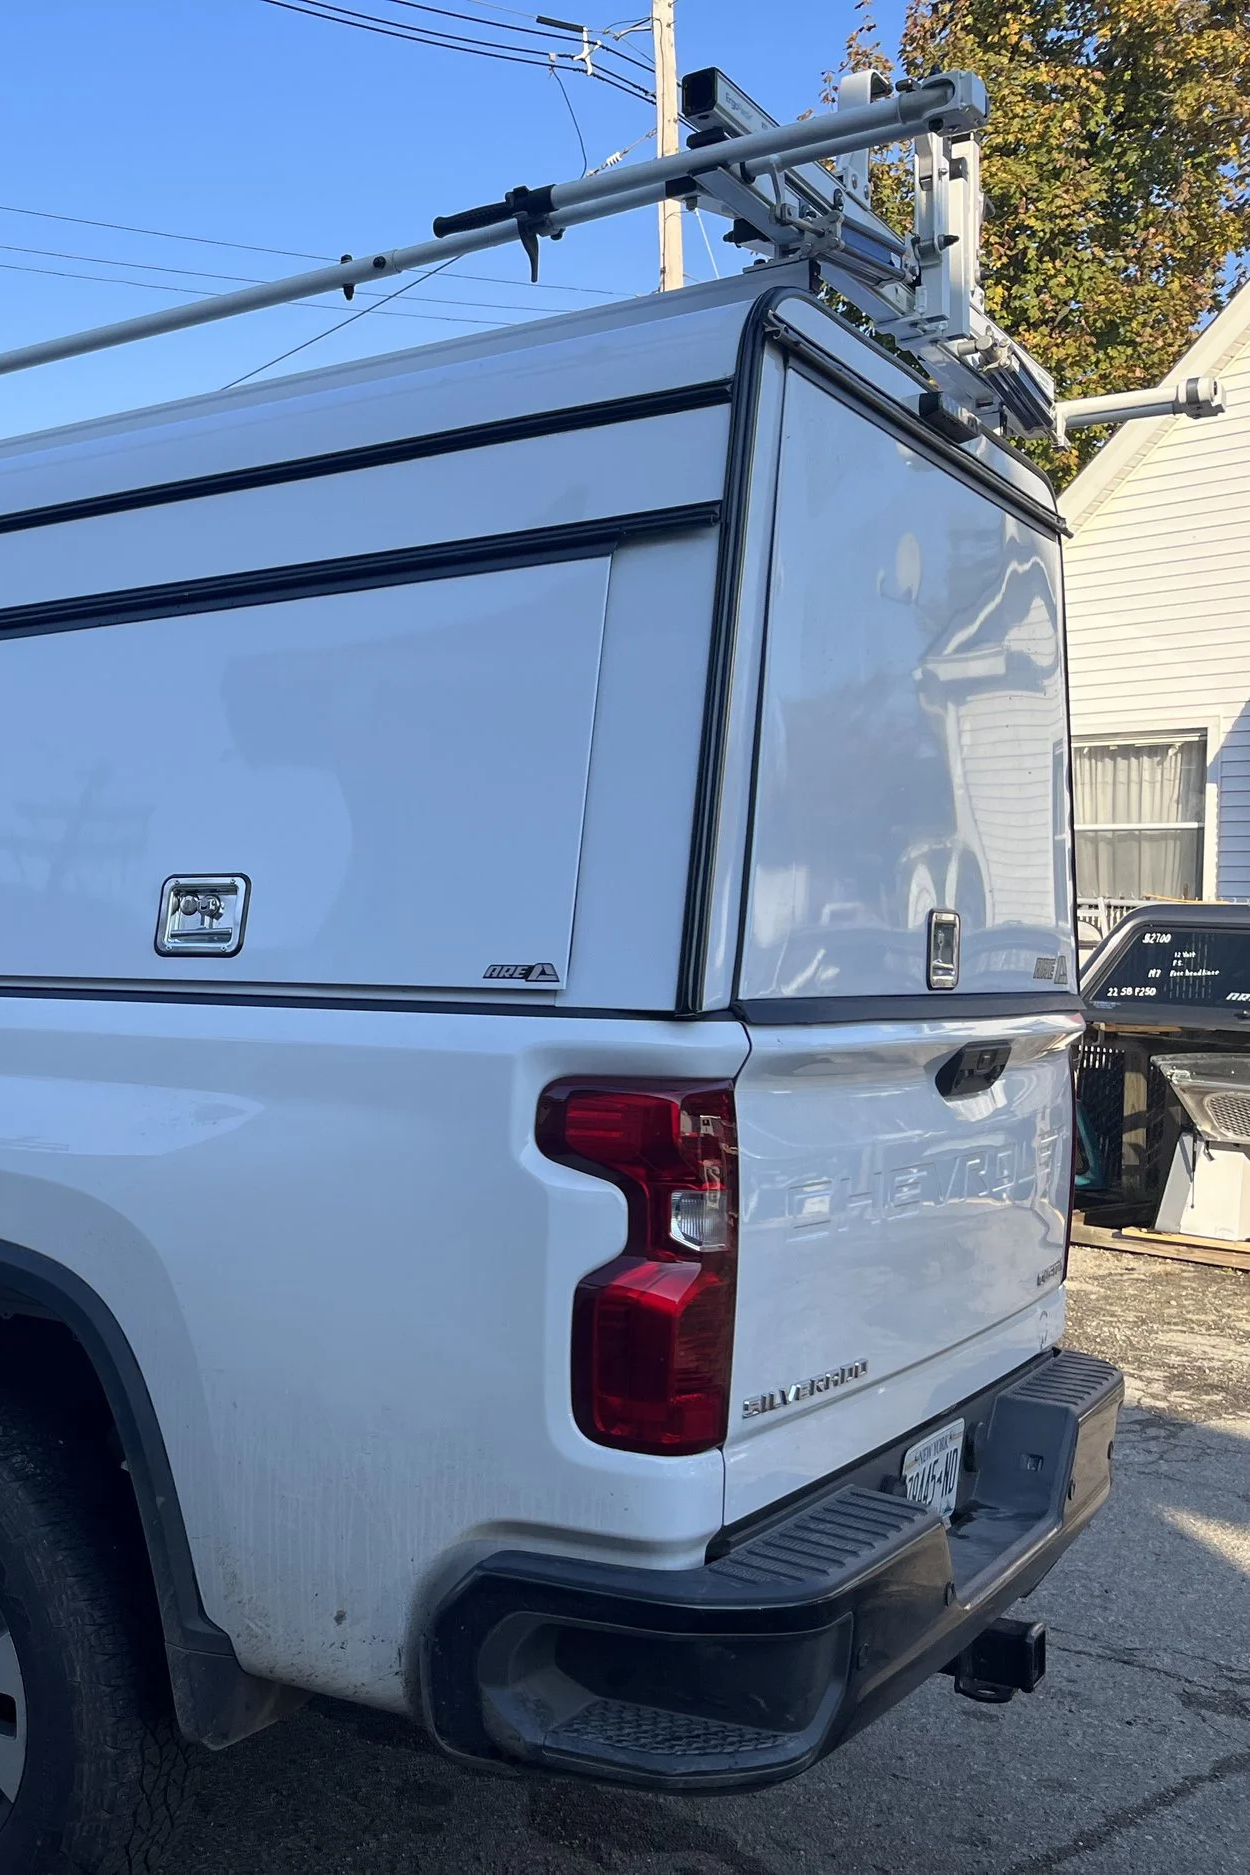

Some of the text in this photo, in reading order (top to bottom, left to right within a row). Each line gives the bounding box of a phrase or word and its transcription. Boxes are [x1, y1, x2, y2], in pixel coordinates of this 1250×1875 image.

[1106, 987, 1118, 996] 22
[1134, 986, 1157, 997] F250
[742, 1358, 869, 1420] SILVERADO
[918, 1435, 950, 1466] NEW YORK
